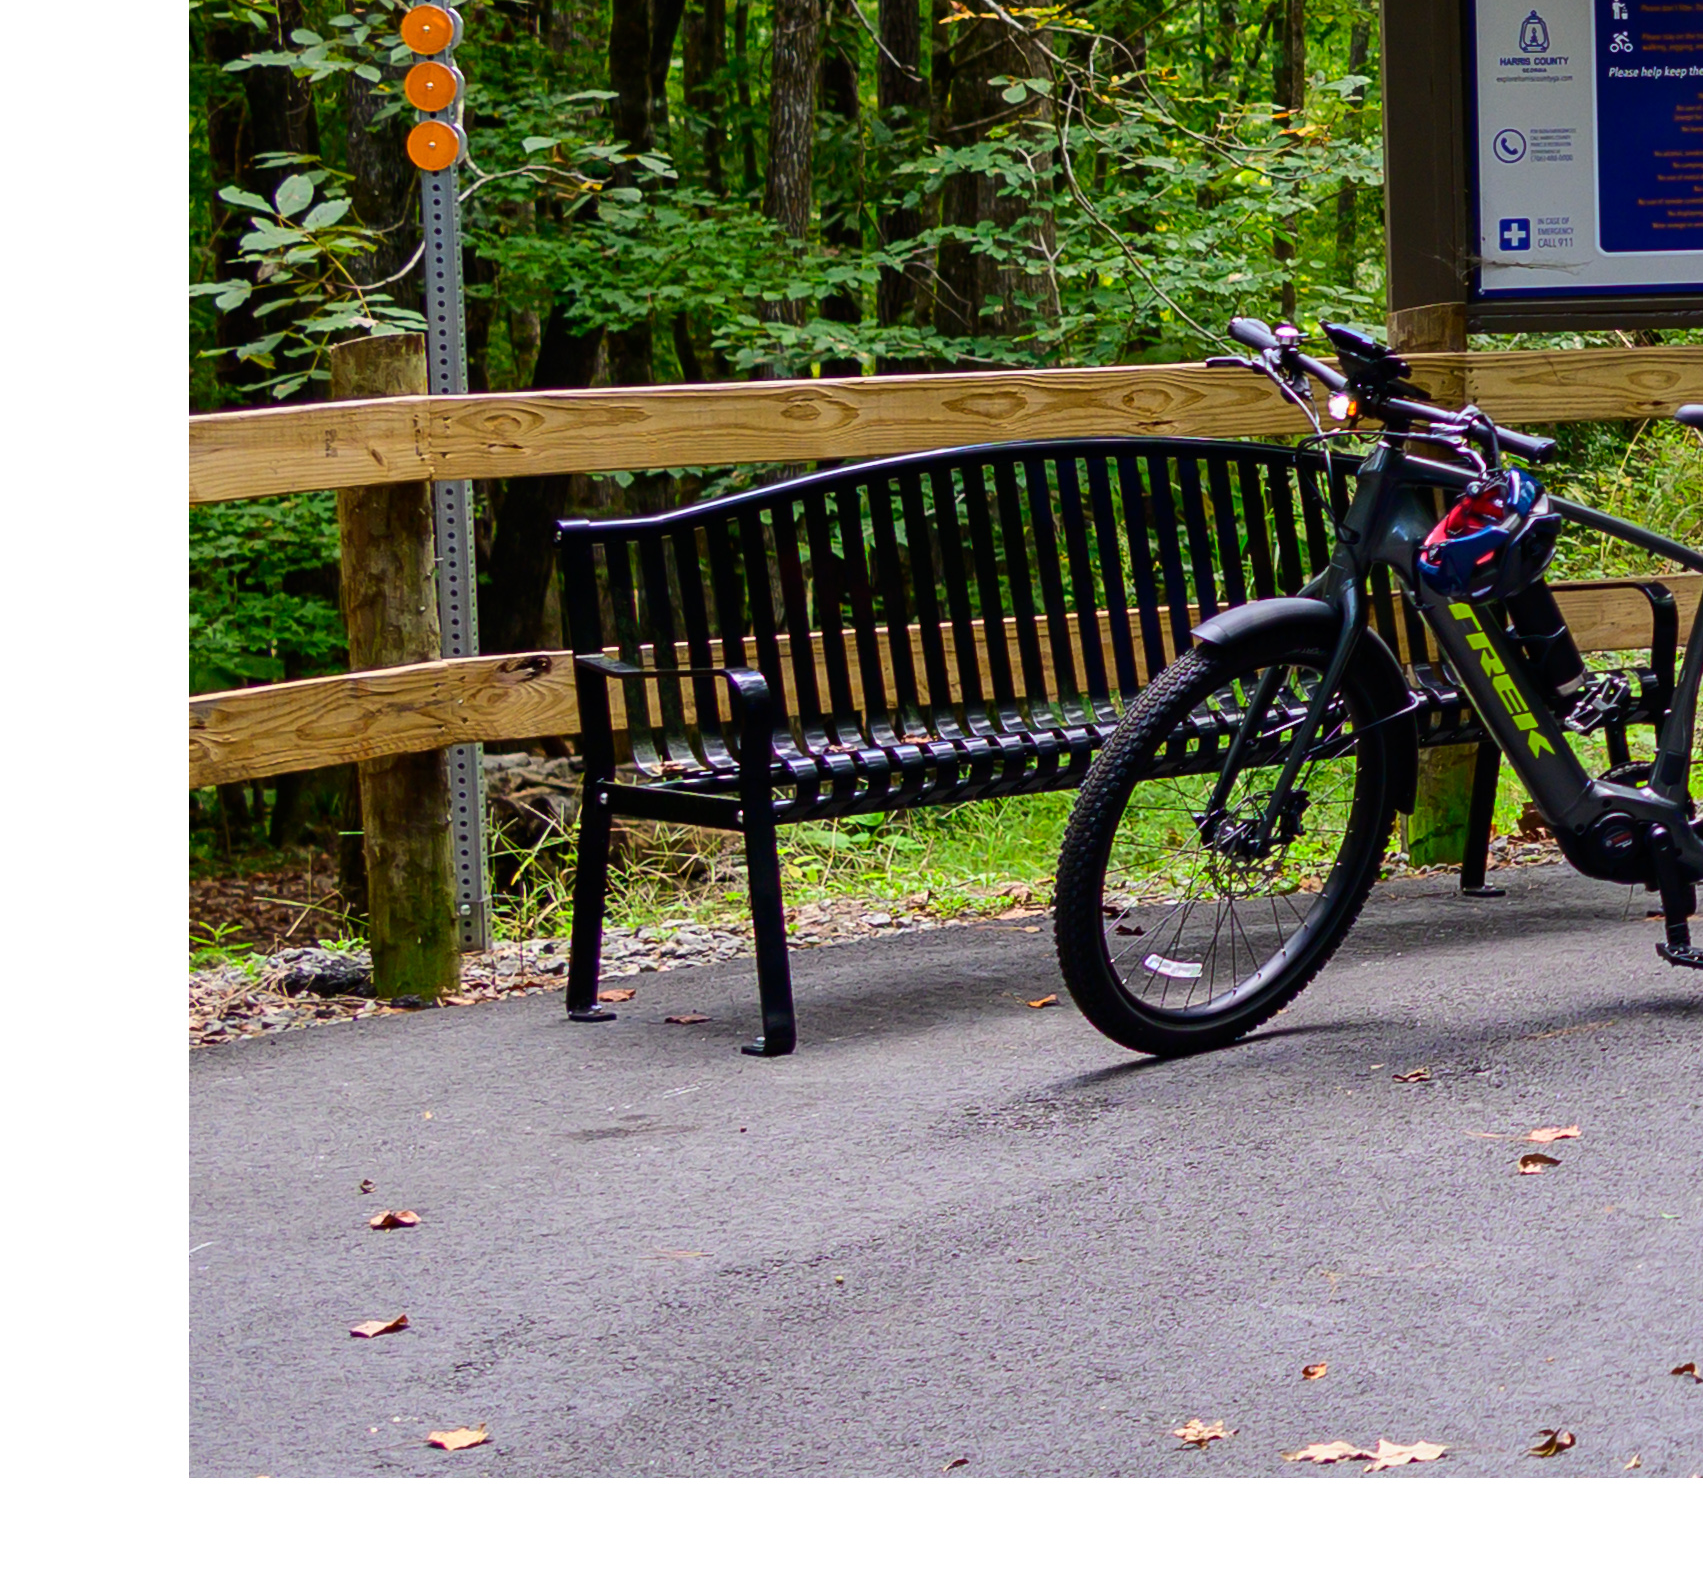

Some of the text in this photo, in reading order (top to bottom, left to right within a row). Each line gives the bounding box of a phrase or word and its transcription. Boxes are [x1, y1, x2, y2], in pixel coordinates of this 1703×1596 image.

[1500, 56, 1568, 65] HARRIS COUNTY
[1609, 66, 1639, 77] Please
[1641, 66, 1663, 79] help
[1664, 66, 1688, 78] keep
[1538, 238, 1574, 248] CALL 911
[1448, 602, 1556, 759] TREK
